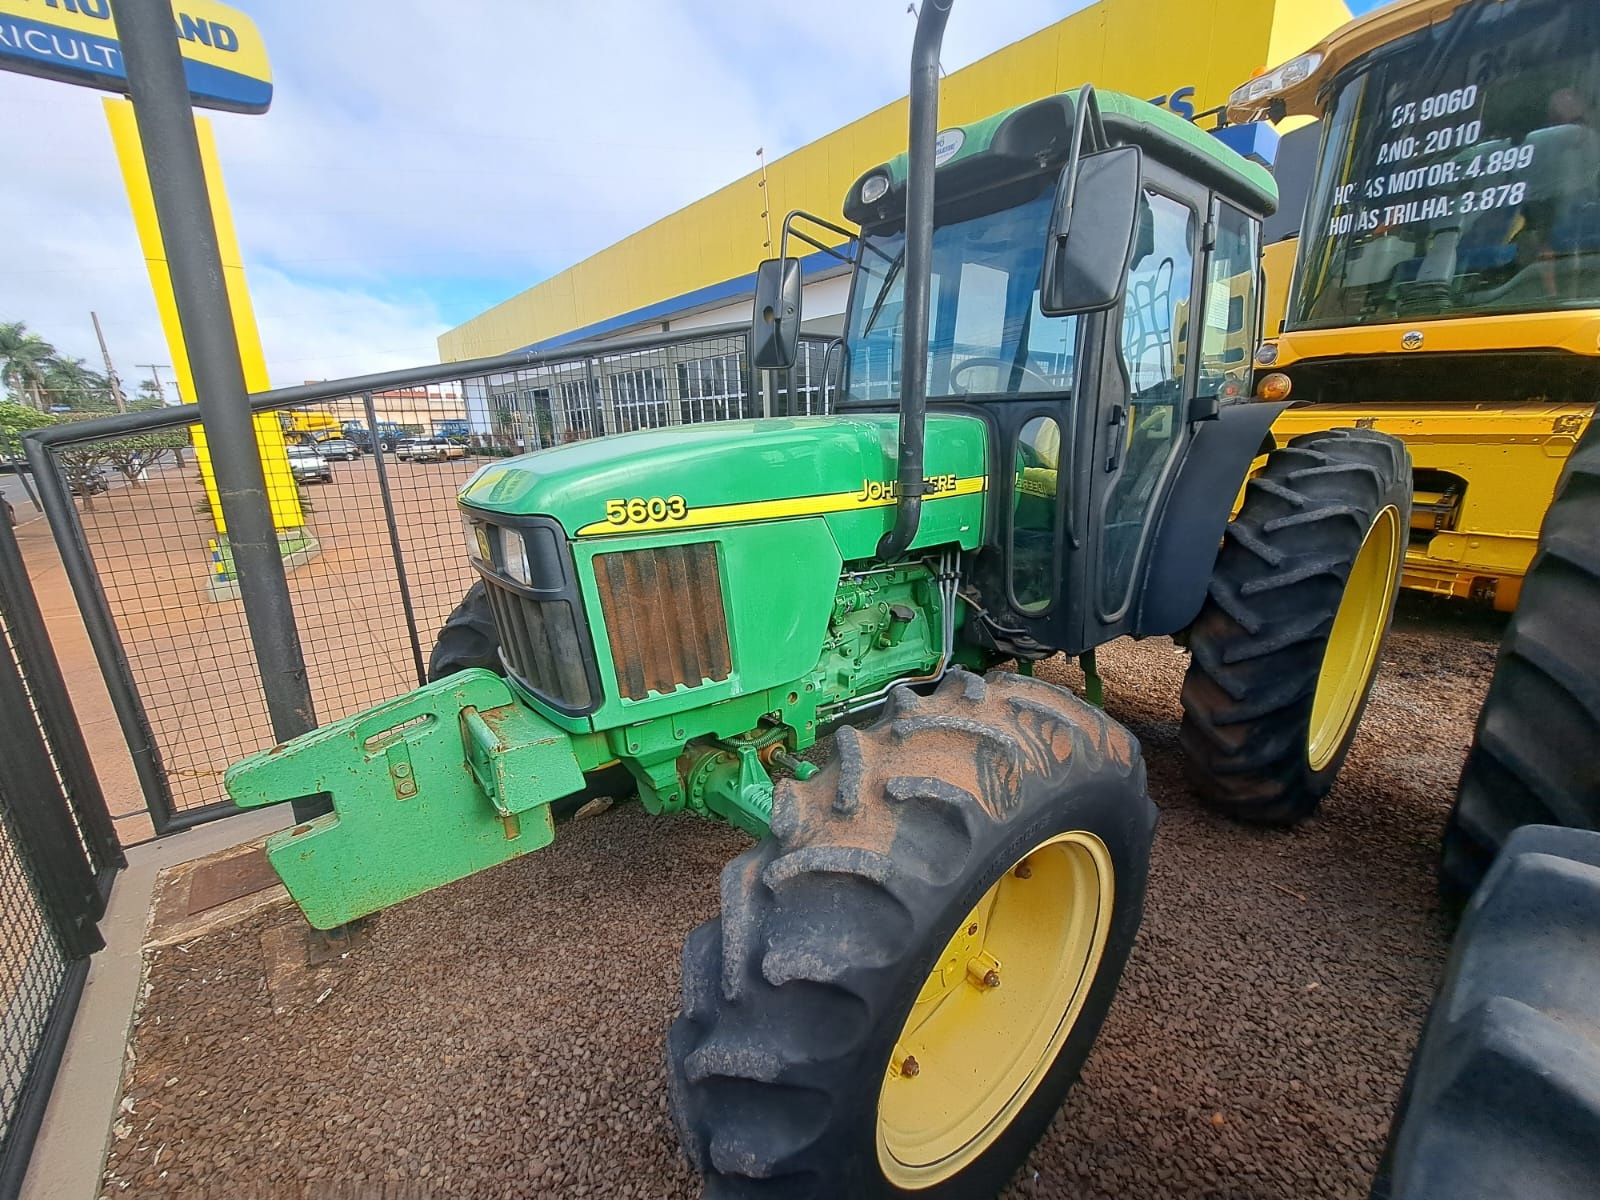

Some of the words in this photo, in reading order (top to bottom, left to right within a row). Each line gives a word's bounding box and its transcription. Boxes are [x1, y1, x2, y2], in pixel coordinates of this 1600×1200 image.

[1420, 84, 1478, 121] 9060
[1376, 136, 1420, 166] ANO:
[1423, 120, 1481, 155] 2010
[1387, 161, 1461, 195] MOTOR:
[1465, 144, 1535, 178] 4.899
[1383, 195, 1455, 227] TRILHA:
[1460, 182, 1527, 214] 3.878
[606, 495, 688, 525] 5603
[857, 479, 898, 502] JOH
